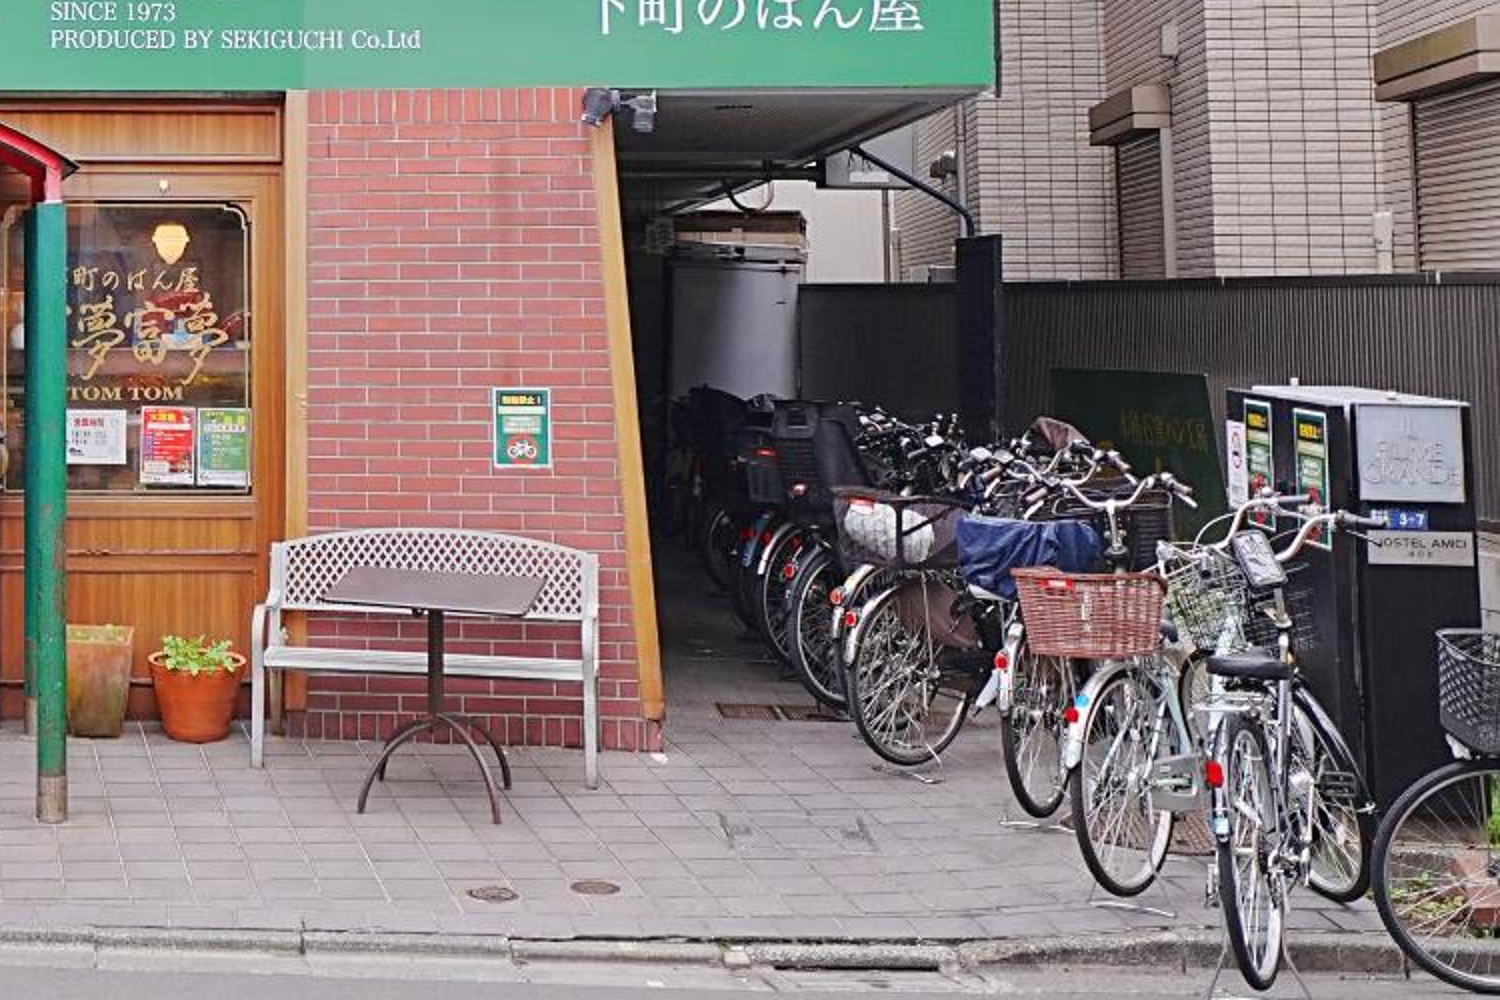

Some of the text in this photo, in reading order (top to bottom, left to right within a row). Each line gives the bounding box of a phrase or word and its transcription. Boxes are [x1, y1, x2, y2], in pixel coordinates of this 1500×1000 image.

[51, 2, 176, 21] SINCE 1973
[51, 29, 421, 50] PRODUCED BY SEKIGUCHI Co.Ltd
